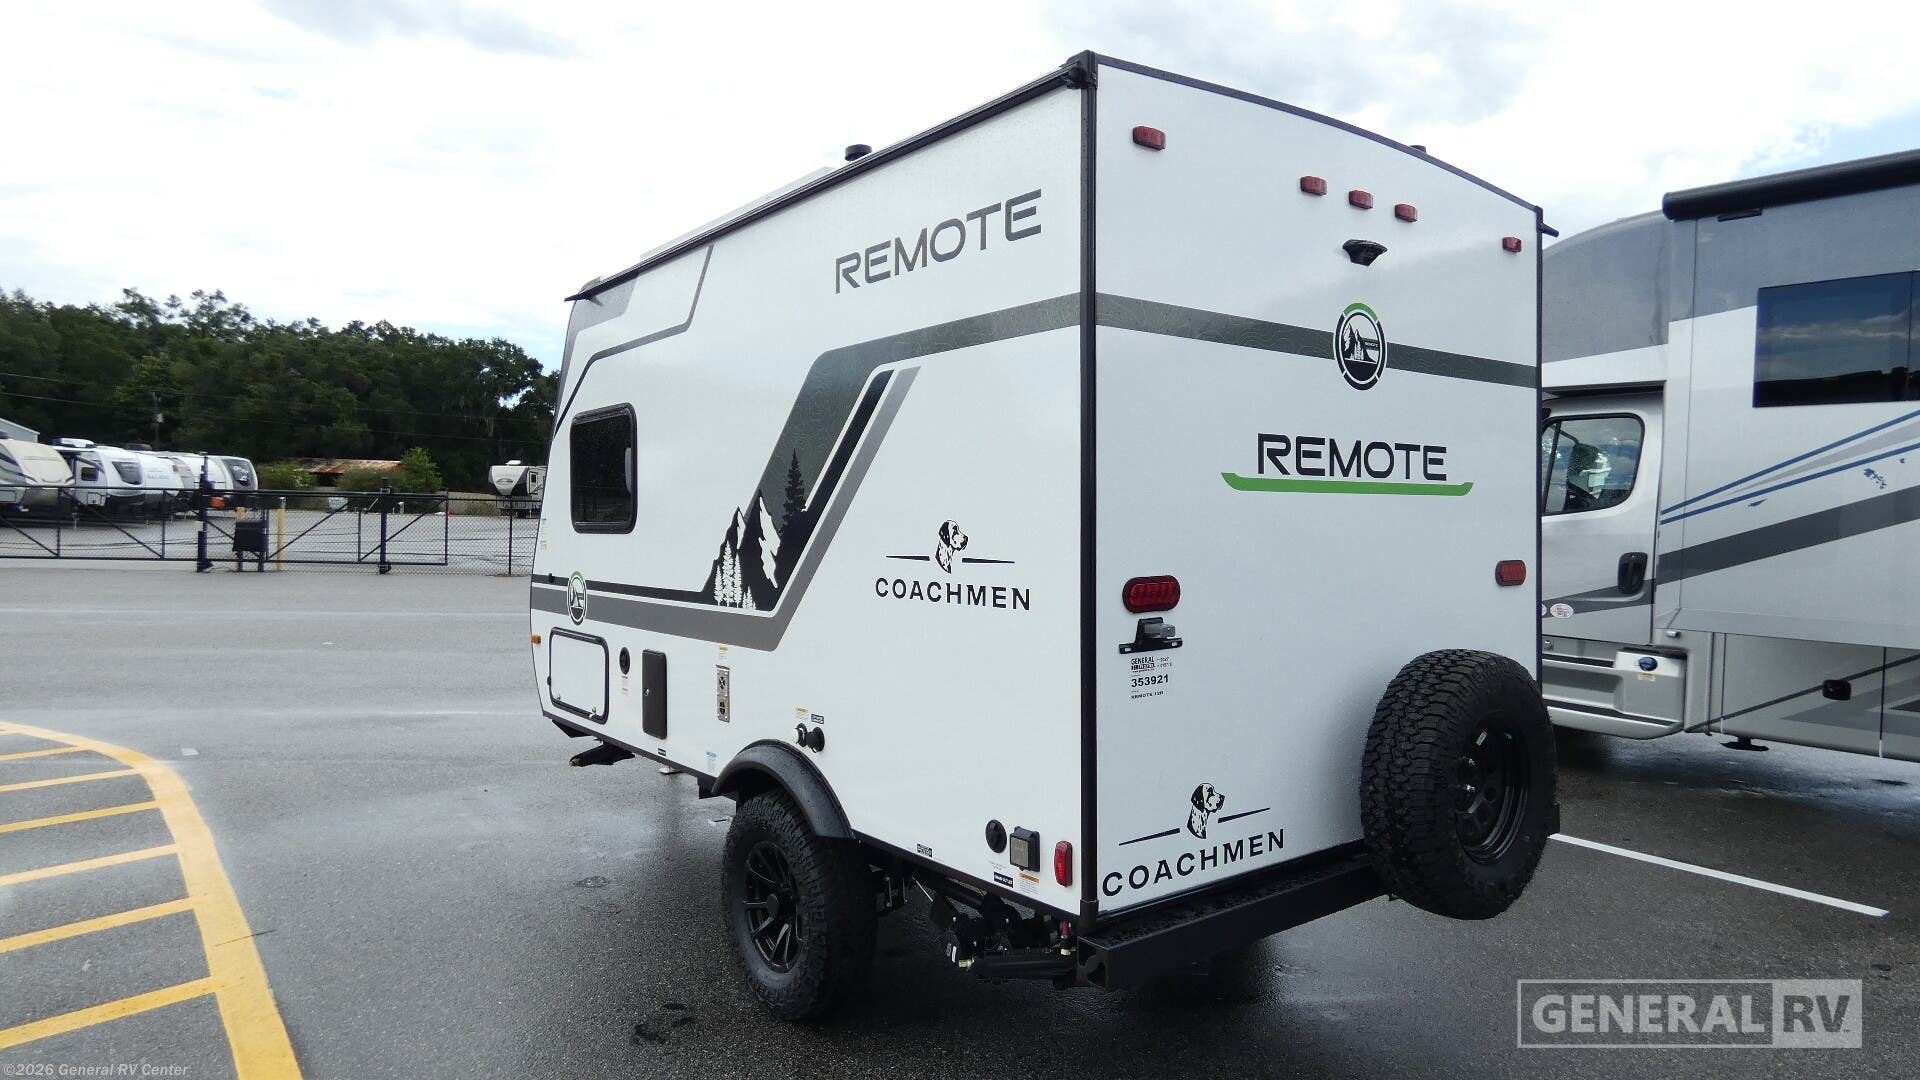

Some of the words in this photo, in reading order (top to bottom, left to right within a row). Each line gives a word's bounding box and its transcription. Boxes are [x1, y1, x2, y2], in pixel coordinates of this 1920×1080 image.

[835, 188, 1042, 294] REMOTE
[1257, 433, 1447, 481] REMOTE
[875, 577, 1031, 611] COACHMEN
[1131, 656, 1155, 664] GENERAL
[1131, 674, 1169, 687] 353921
[1102, 828, 1284, 897] COACHMEN
